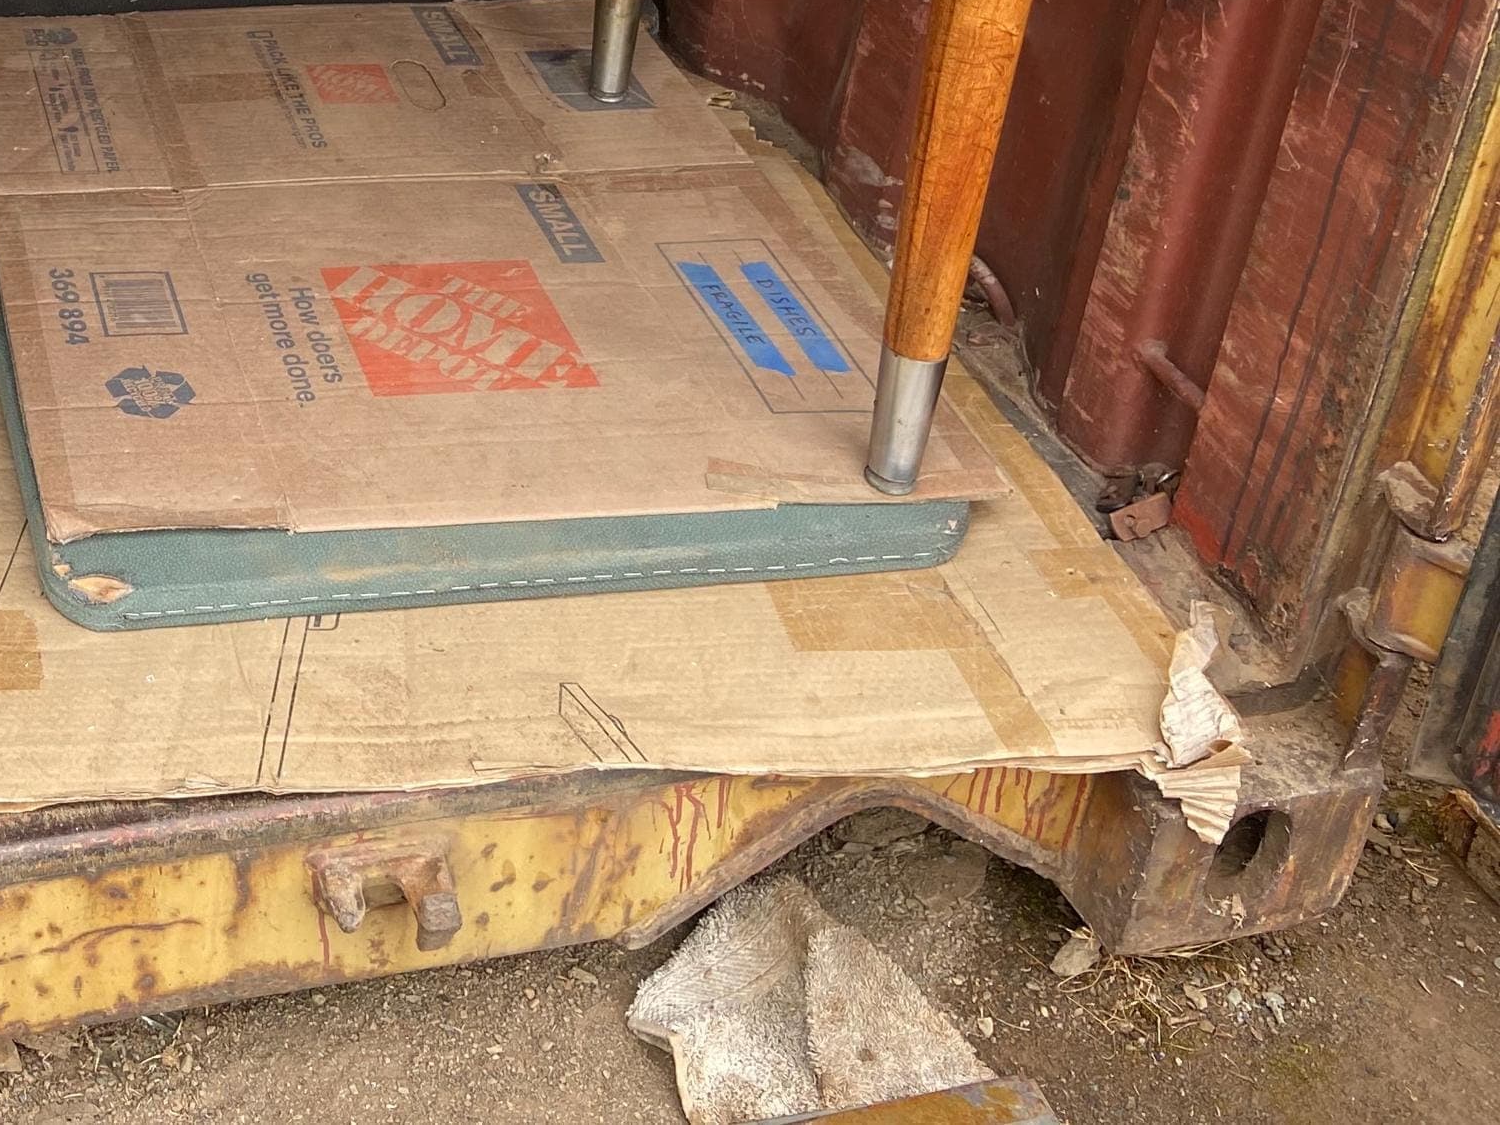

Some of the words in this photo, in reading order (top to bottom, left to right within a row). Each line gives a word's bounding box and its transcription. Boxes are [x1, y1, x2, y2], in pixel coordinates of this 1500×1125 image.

[262, 38, 289, 67] PACK
[422, 11, 469, 60] SMALL
[277, 66, 301, 98] LIKE
[291, 92, 312, 117] THE
[300, 117, 328, 149] PROS
[101, 146, 120, 173] PAPER
[529, 189, 587, 256] SMALL
[49, 268, 80, 303] 369
[245, 273, 280, 299] get
[439, 273, 536, 323] THE
[755, 279, 817, 339] DISHES
[58, 308, 90, 345] 894
[262, 303, 296, 349] more
[288, 287, 320, 326] How
[306, 331, 343, 383] doers
[331, 266, 591, 390] HOME
[702, 284, 766, 345] FRAGILE
[348, 316, 514, 392] DEPOT
[282, 354, 316, 408] done.
